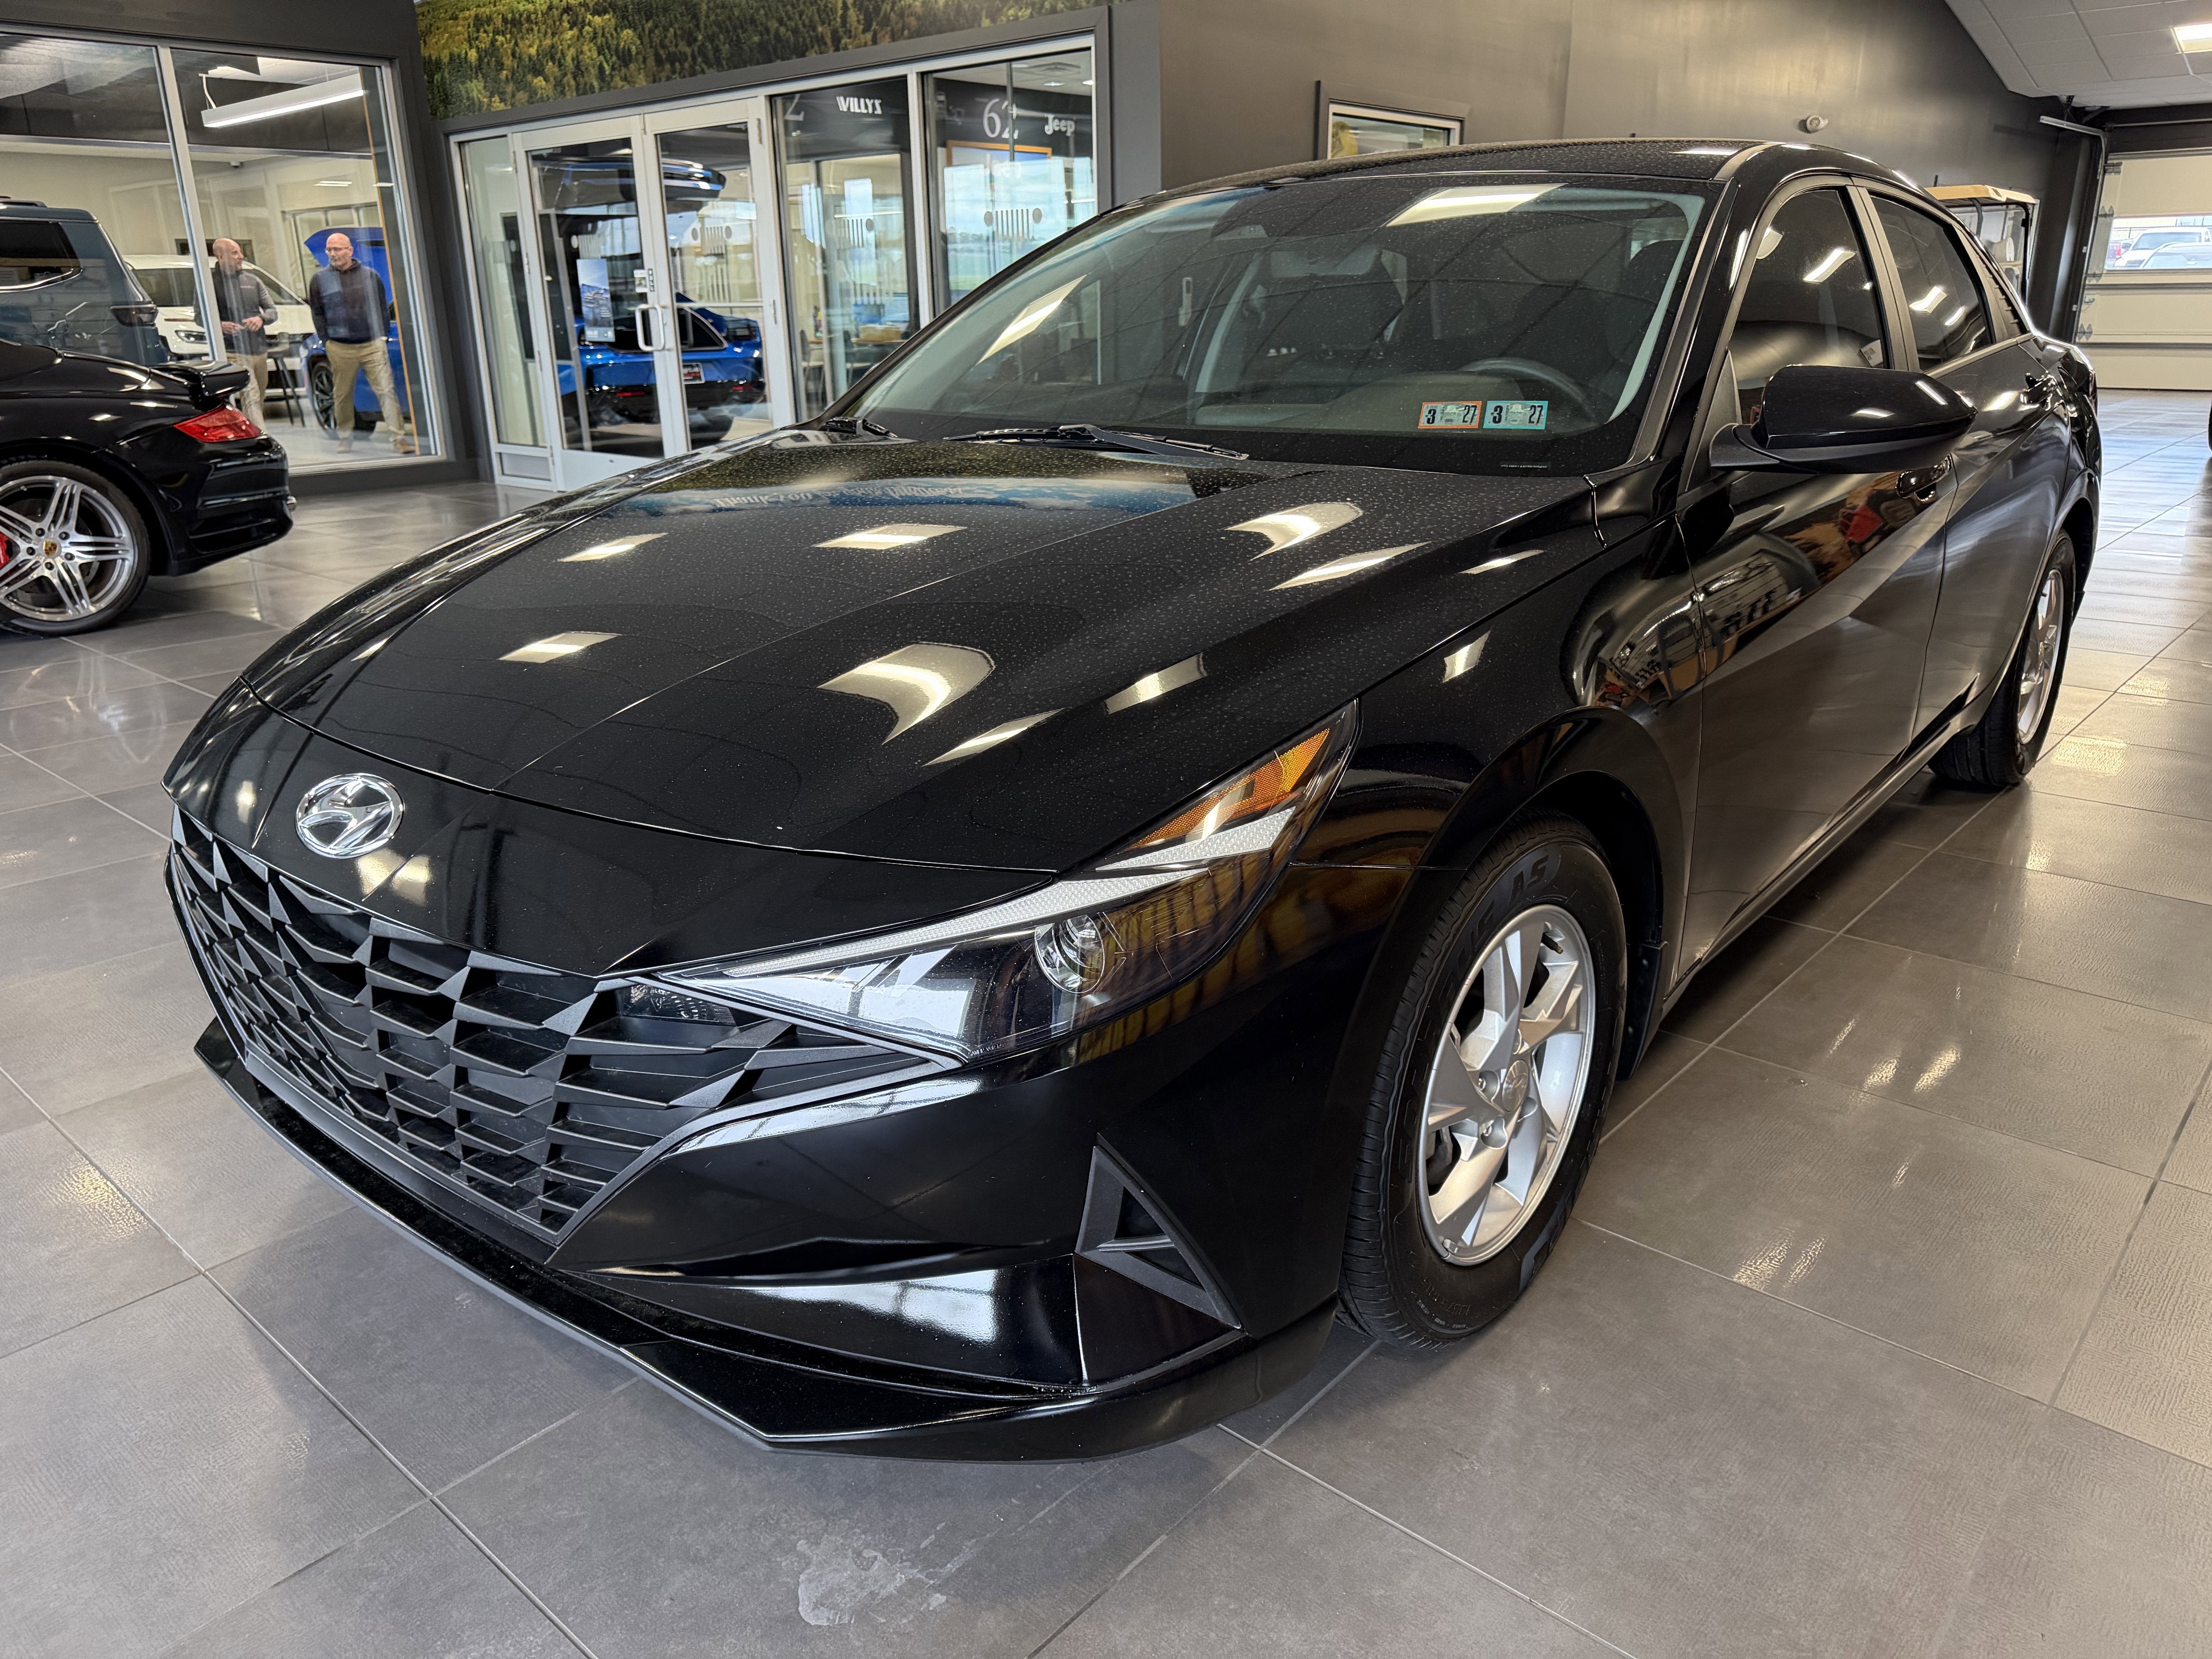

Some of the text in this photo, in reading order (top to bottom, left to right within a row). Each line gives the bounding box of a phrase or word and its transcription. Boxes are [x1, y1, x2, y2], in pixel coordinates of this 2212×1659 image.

[836, 95, 883, 115] WILLYS
[983, 98, 1019, 139] 62
[1044, 114, 1075, 136] Jeep
[1427, 409, 1437, 424] 3
[1462, 405, 1477, 424] 27
[1492, 405, 1503, 424] 3
[1528, 405, 1543, 424] 27
